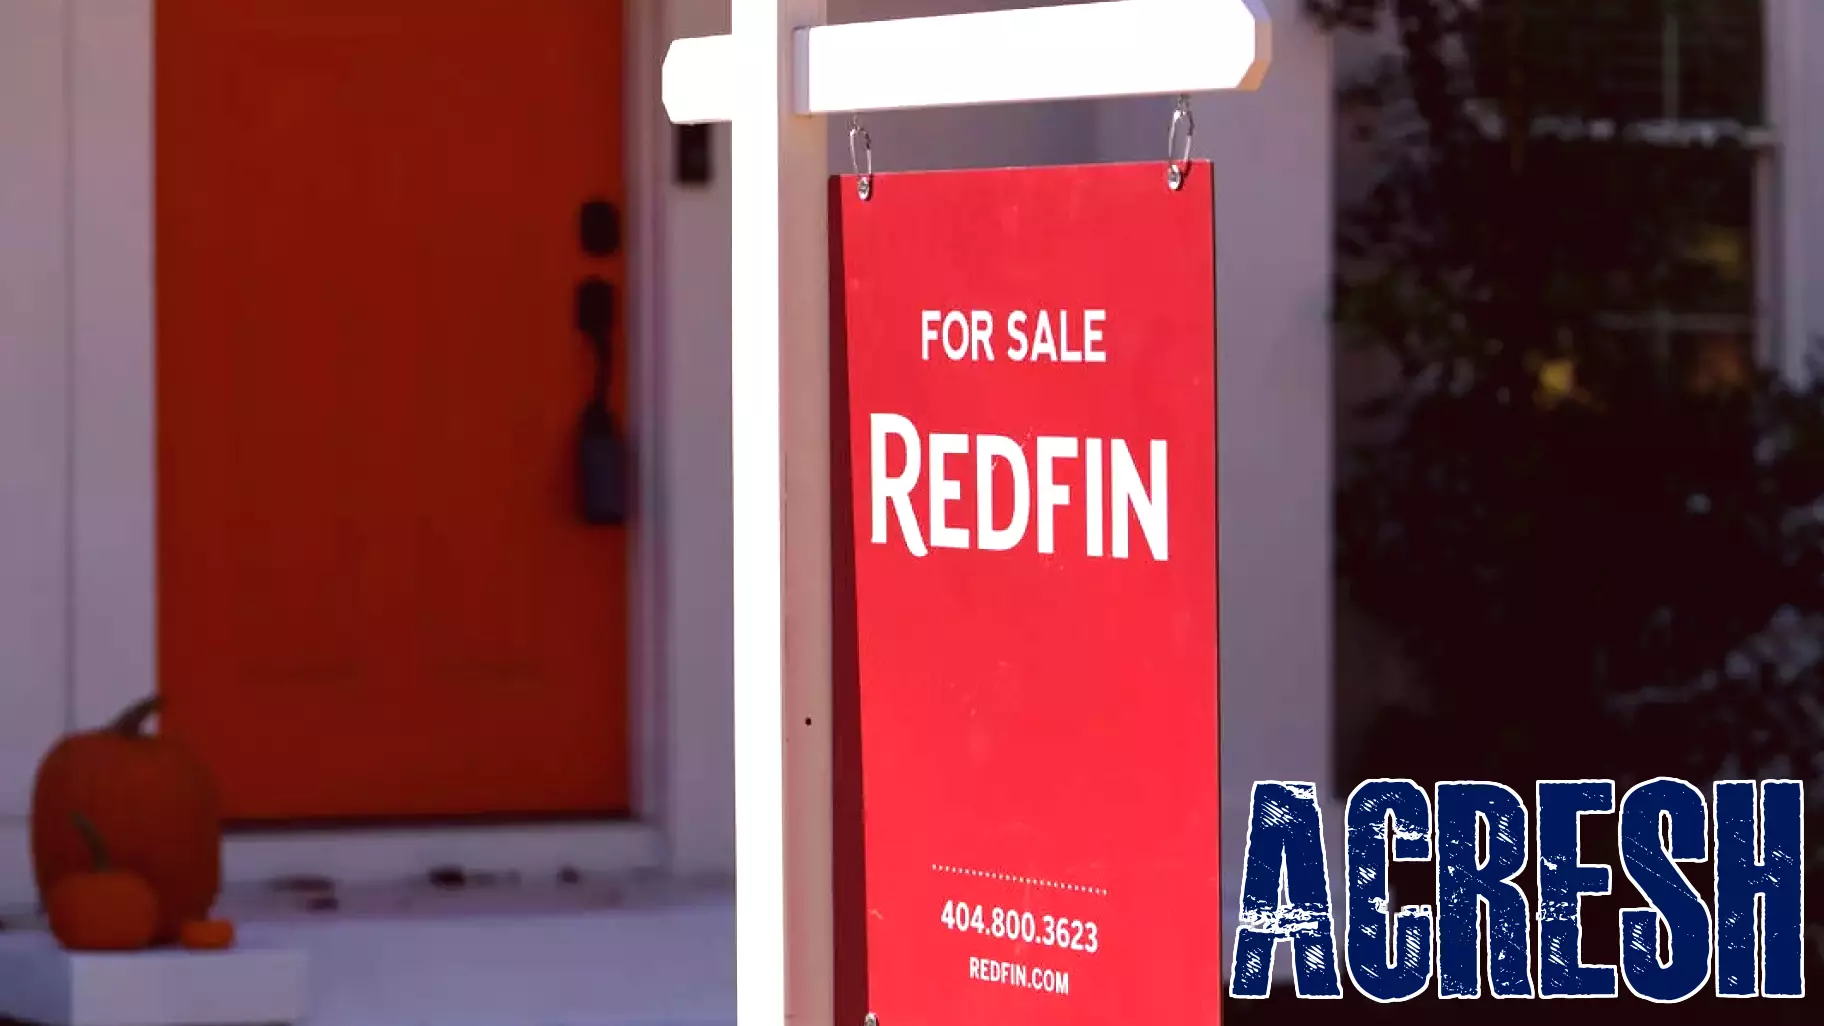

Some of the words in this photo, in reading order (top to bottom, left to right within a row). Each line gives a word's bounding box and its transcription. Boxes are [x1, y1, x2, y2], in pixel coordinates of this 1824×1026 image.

[921, 309, 995, 362] FOR
[1007, 309, 1107, 363] SALE
[870, 412, 1169, 562] REDFIN
[940, 899, 1099, 953] 404.800.3623
[969, 956, 1069, 995] REDFIN.COM
